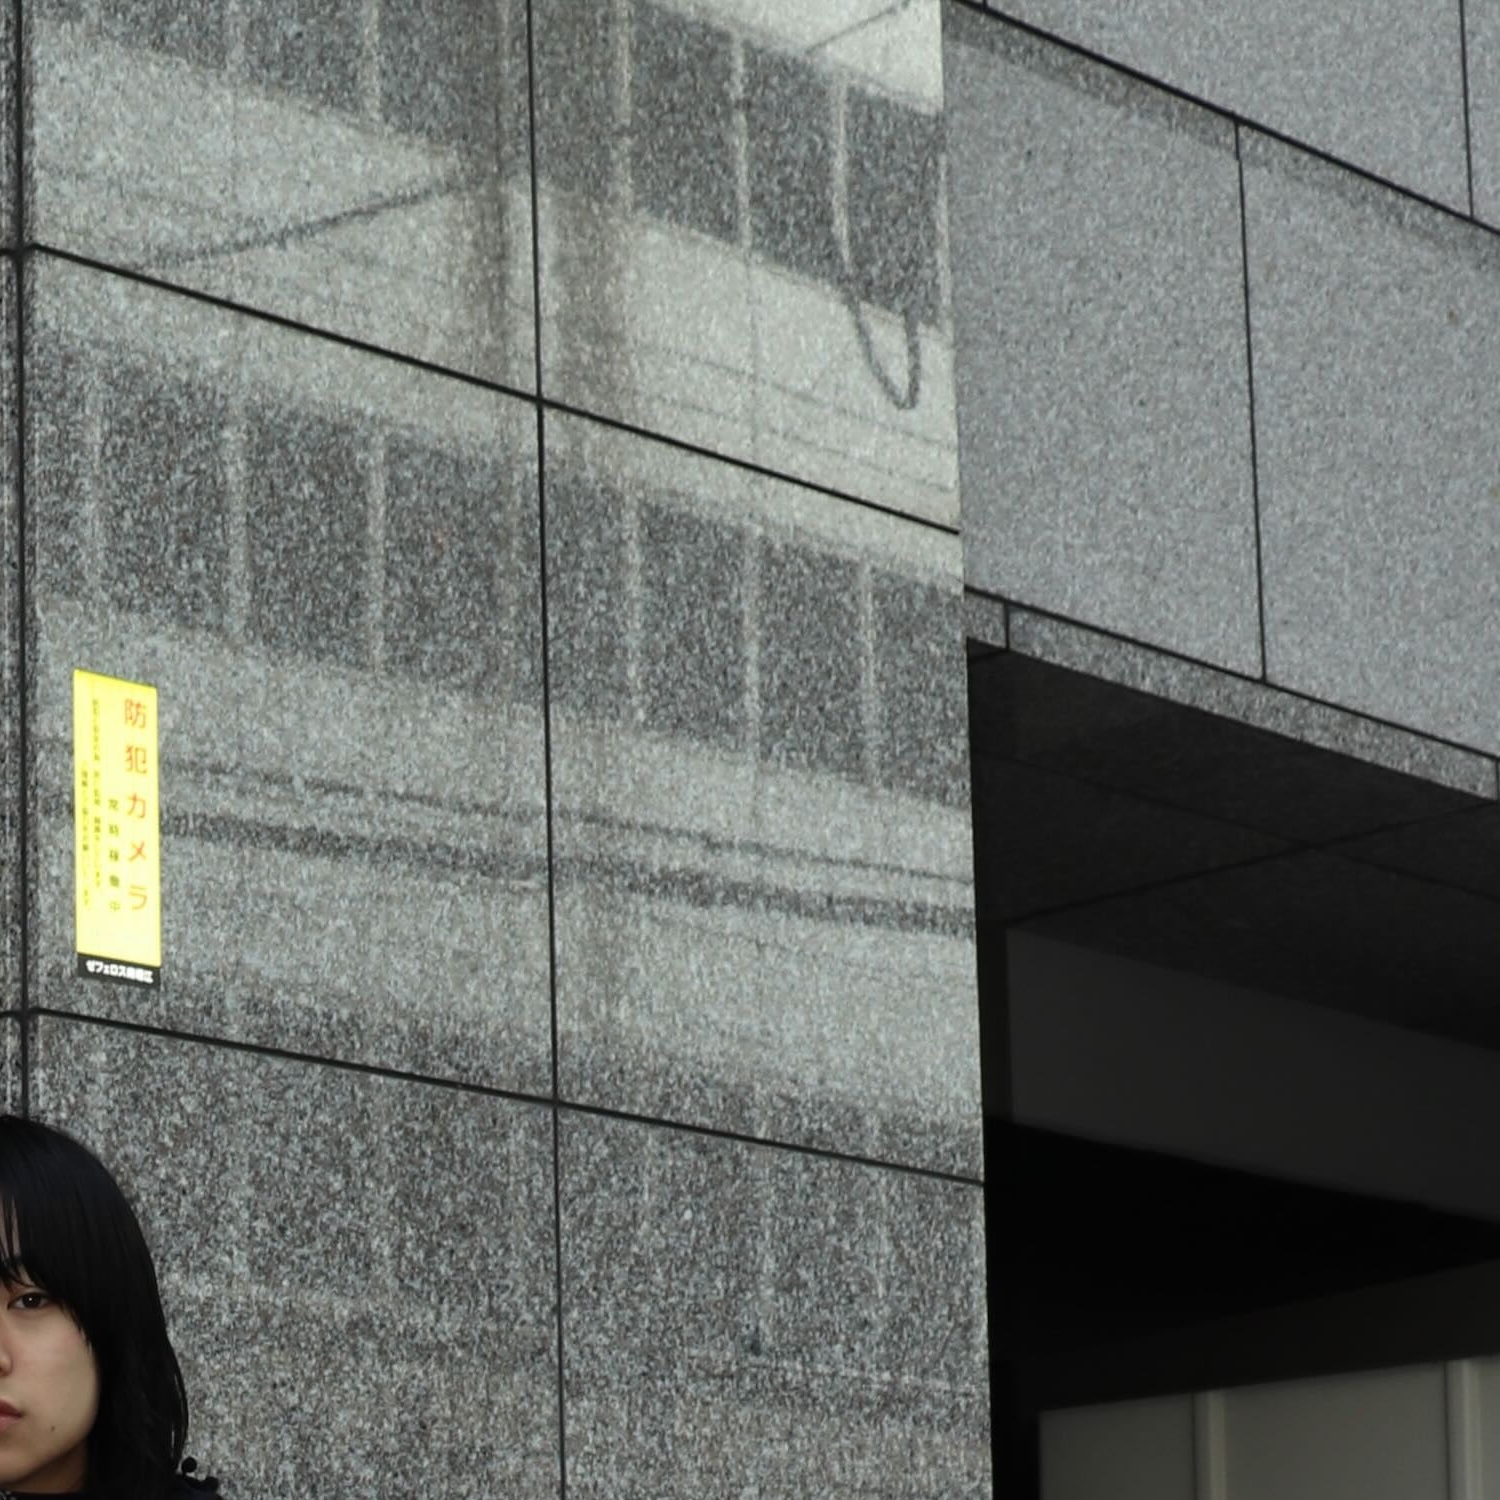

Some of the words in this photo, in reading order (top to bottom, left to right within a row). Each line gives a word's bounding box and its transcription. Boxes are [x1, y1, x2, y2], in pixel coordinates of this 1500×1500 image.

[124, 698, 149, 911] 防犯カメラ
